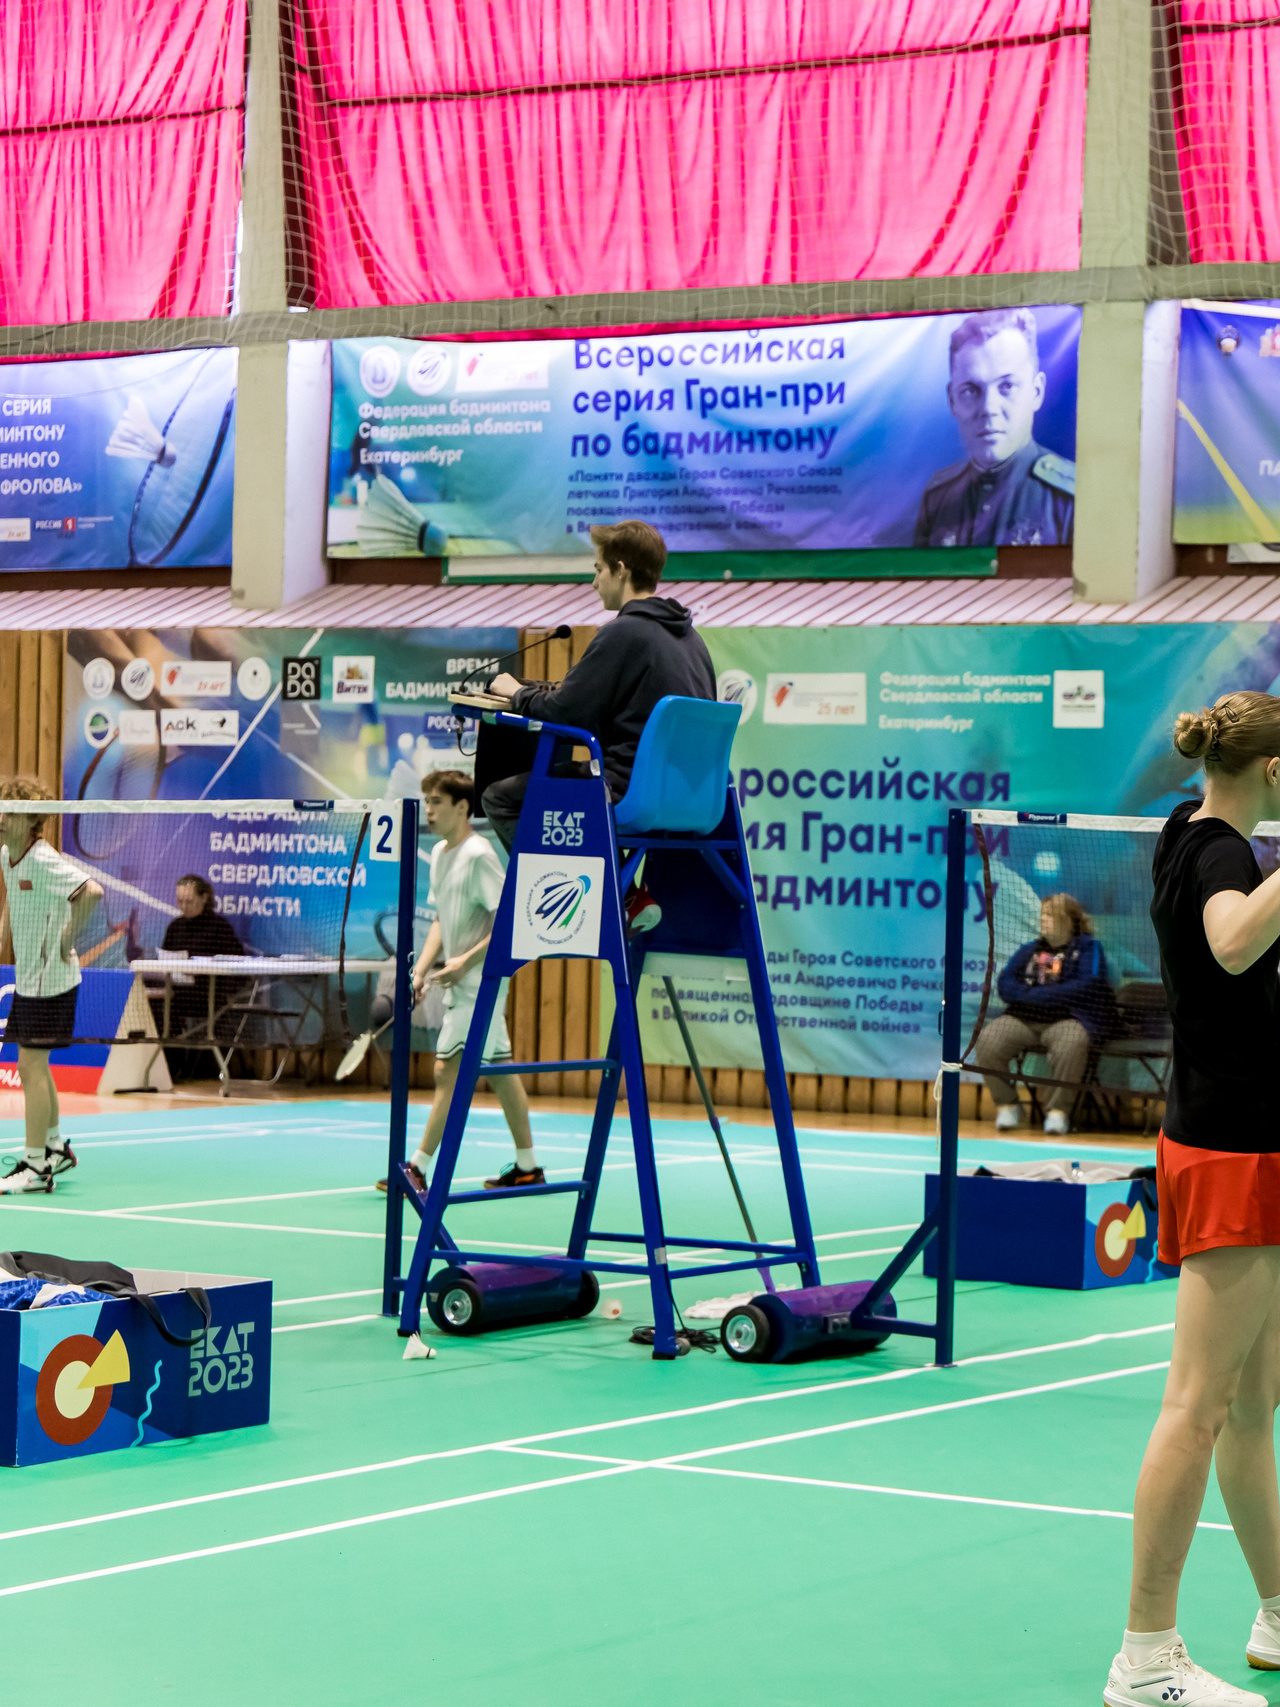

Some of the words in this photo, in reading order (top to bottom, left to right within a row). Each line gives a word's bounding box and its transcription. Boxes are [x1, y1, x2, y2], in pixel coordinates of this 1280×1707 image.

[574, 329, 846, 377] Всероссийская
[2, 398, 52, 416] СЕРИЯ
[358, 402, 447, 420] Федерация
[449, 399, 550, 417] бадминтона
[572, 388, 674, 421] серия
[685, 378, 846, 418] Гран-при
[358, 419, 471, 440] Свердловской
[473, 418, 543, 436] области
[571, 433, 611, 457] по
[622, 422, 838, 459] бадминтону
[359, 446, 464, 466] Екатеринбург
[446, 657, 500, 675] ВРЕМЯ
[879, 671, 961, 687] Федерация
[962, 671, 1051, 687] бадминтона
[385, 681, 493, 700] БАДМИНТОН
[880, 688, 981, 705] Свердловской
[983, 688, 1044, 703] области
[878, 714, 974, 733] Екатеринбург
[738, 756, 1011, 807] российская
[209, 831, 348, 856] БАДМИНТОНА
[376, 815, 394, 853] 2
[541, 827, 584, 846] 2023
[207, 862, 368, 887] СВЕРДЛОВСКОЙ
[214, 895, 301, 917] ОБЛАСТИ
[752, 873, 1000, 923] админтоу
[793, 948, 837, 968] Героя
[841, 951, 937, 970] Советского
[795, 970, 897, 991] Андреевича
[901, 975, 993, 993] Речков
[651, 987, 753, 1003] повященна
[772, 994, 851, 1009] одовщине
[855, 993, 923, 1014] Победы
[662, 1005, 729, 1022] Вликой
[734, 1009, 857, 1032] Отственной
[861, 1014, 921, 1034] войне»
[188, 1353, 254, 1397] 2023
